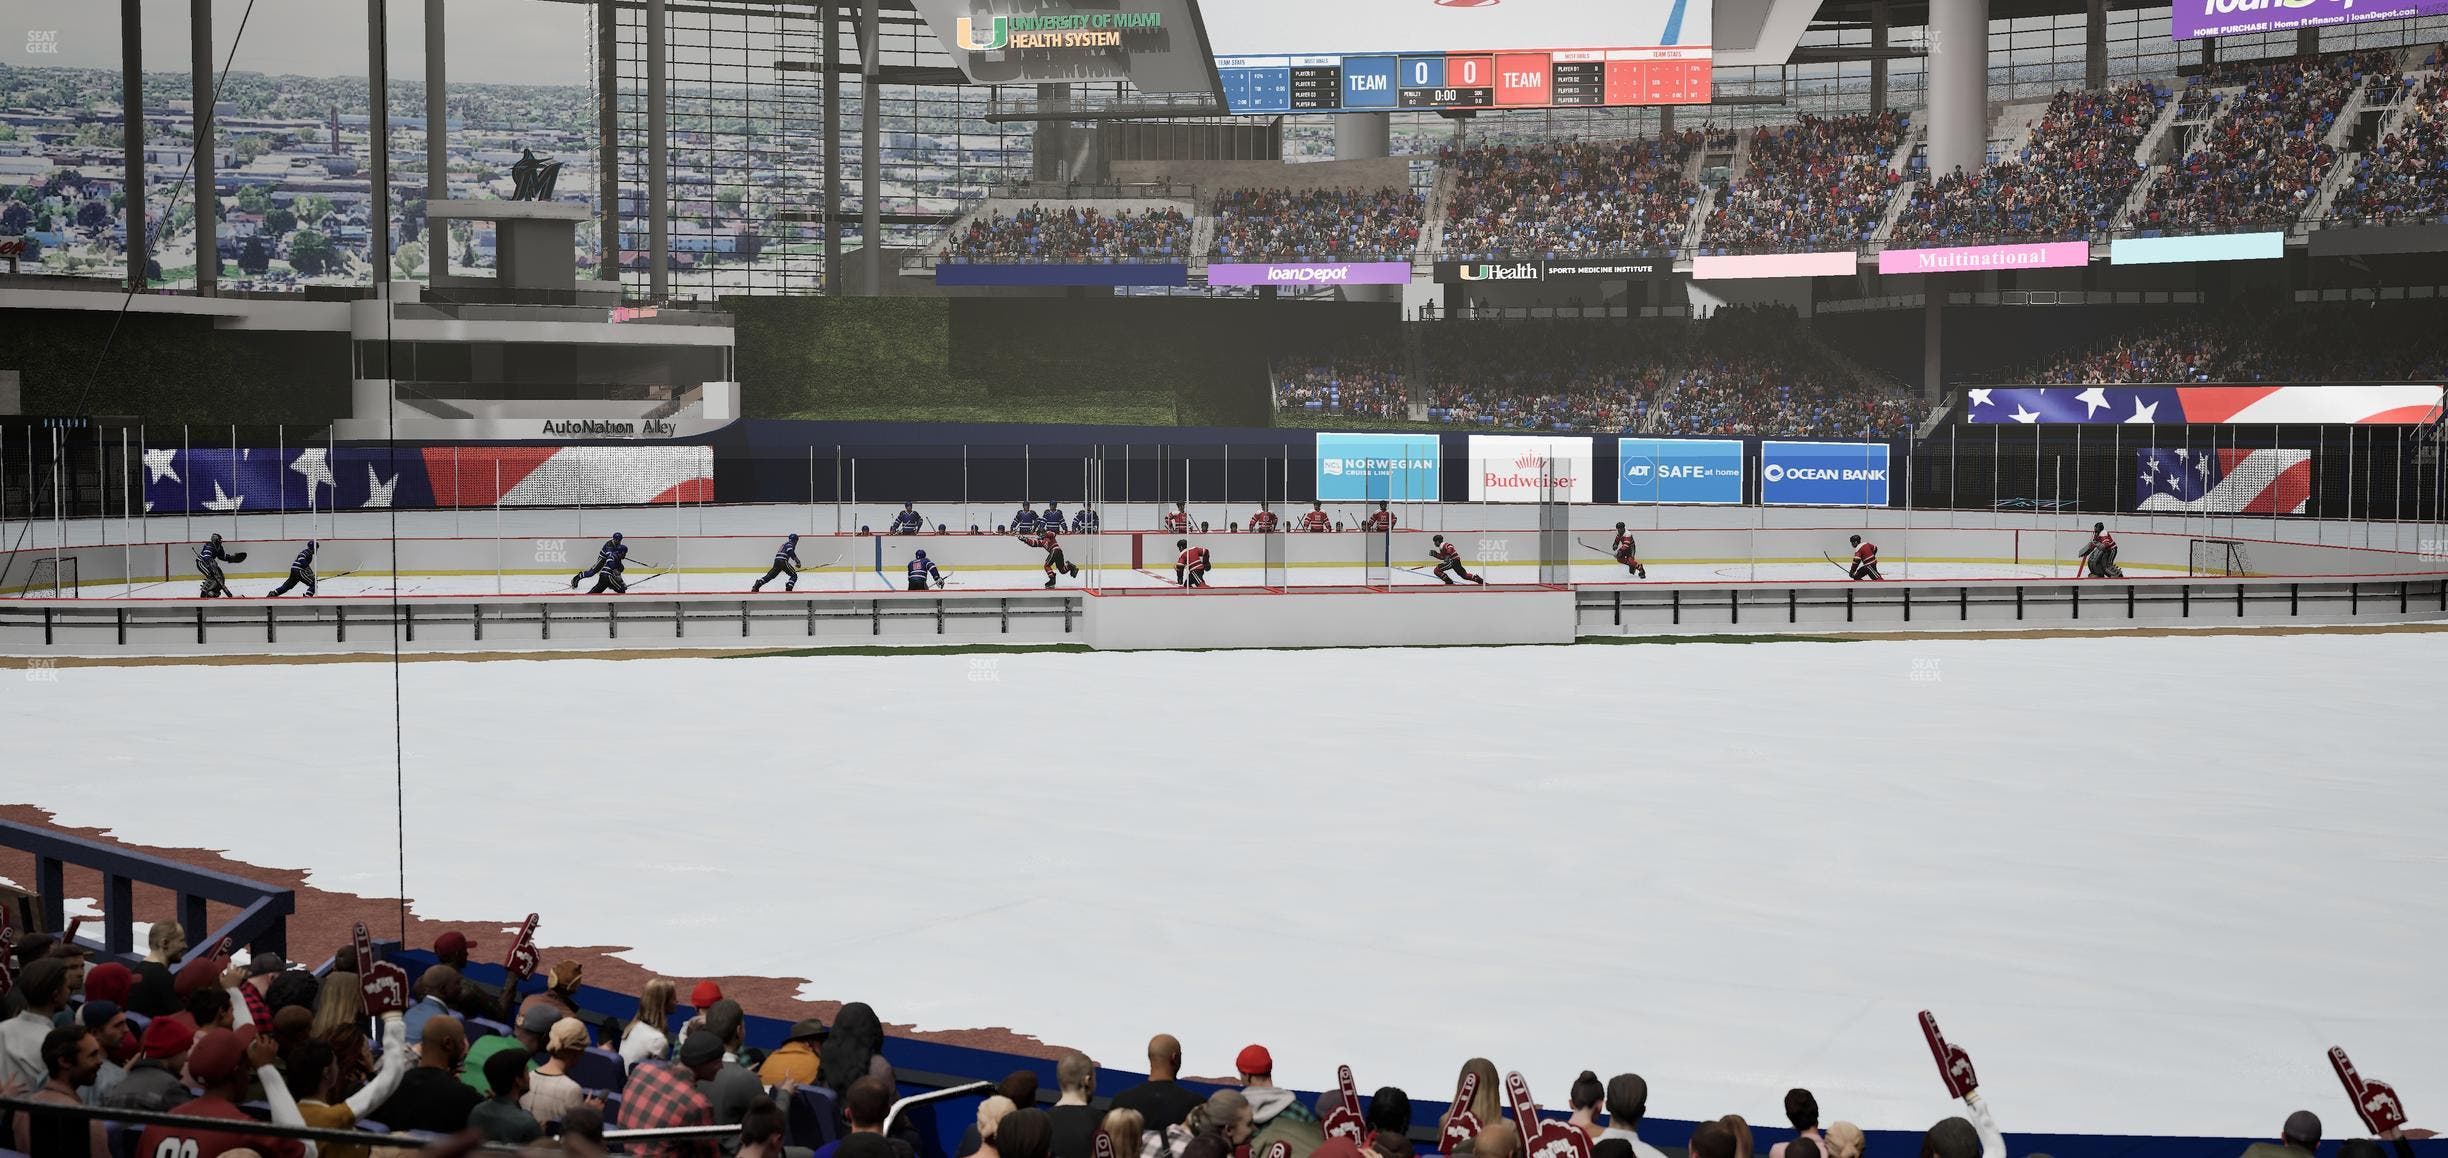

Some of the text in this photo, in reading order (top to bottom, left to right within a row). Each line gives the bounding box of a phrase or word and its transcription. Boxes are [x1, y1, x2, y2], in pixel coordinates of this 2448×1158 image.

[1009, 13, 1160, 31] UNIVERSITY OF MIAMI
[2193, 27, 2219, 36] HOME
[2221, 22, 2267, 34] PURCHASE
[2274, 20, 2299, 29] Home
[2301, 15, 2344, 26] Refinance
[1010, 32, 1120, 48] HEALTH SYSTEM
[1415, 61, 1428, 84] 0
[1464, 60, 1476, 84] 0
[1503, 72, 1541, 88] TEAM
[1350, 75, 1387, 91] TEAM
[1435, 90, 1457, 101] 0:00
[1919, 249, 2047, 268] Multinational
[1267, 265, 1347, 283] loanDepot
[1578, 266, 1613, 274] MEDICINE
[1614, 265, 1653, 273] INSTITUTE
[543, 419, 677, 437] AutoNation Alley
[1345, 459, 1433, 470] NORWEGIAN
[1628, 466, 1650, 477] ADT
[1658, 465, 1704, 478] SAFE
[1485, 473, 1577, 488] Budweiser
[1786, 467, 1886, 481] OCEAN BANK
